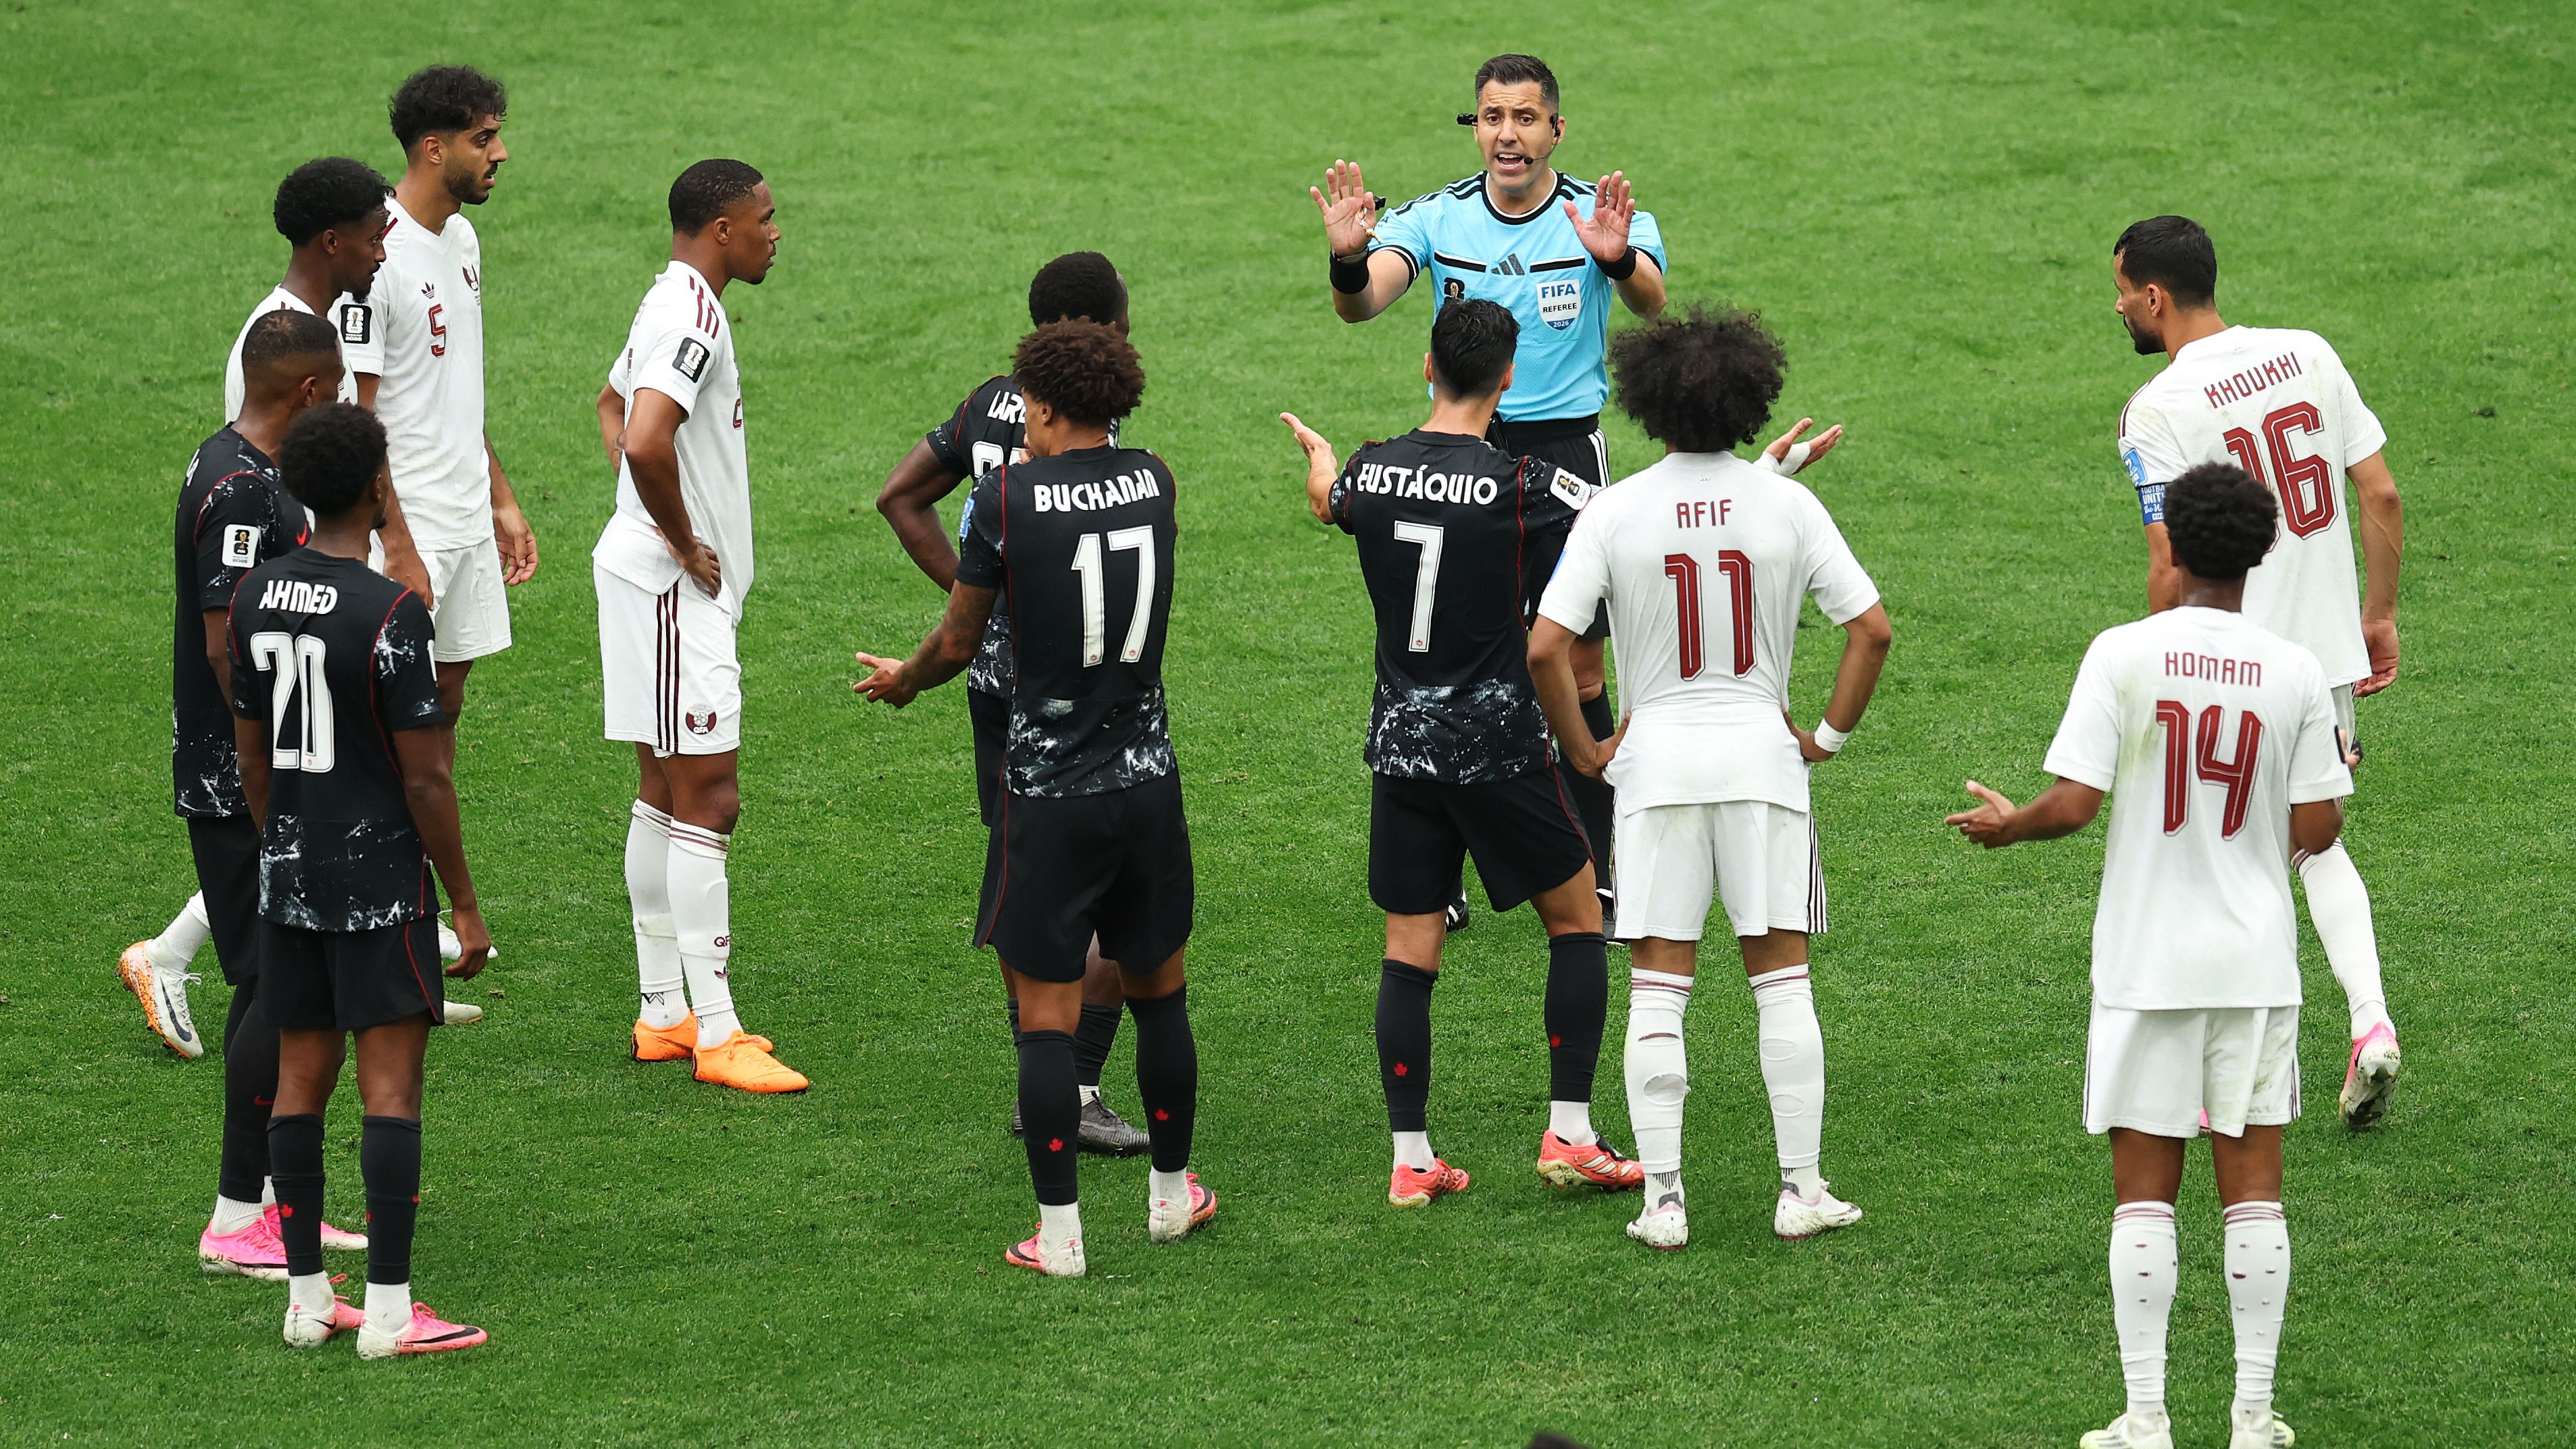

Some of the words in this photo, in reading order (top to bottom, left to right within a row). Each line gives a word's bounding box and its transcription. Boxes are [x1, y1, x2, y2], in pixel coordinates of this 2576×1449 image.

[1541, 283, 1576, 299] FIFA
[1543, 303, 1577, 313] REFEREE
[428, 303, 446, 358] 5
[2204, 351, 2302, 409] KHOUKHI
[987, 390, 1026, 424] LAR
[1034, 468, 1160, 513] BUCHANAN
[1357, 463, 1498, 505] EUSTÁQUIO
[2142, 484, 2165, 494] FOOTBA
[2143, 492, 2165, 504] UNIT
[1676, 499, 1732, 529] AFIF
[259, 580, 338, 615] AHMED
[1071, 525, 1156, 668] 17
[1394, 520, 1444, 653] 7
[1665, 550, 1758, 682] 11
[2165, 652, 2261, 687] HOMAM
[250, 632, 334, 773] 20
[2156, 700, 2265, 842] 14
[713, 935, 730, 947] QF
